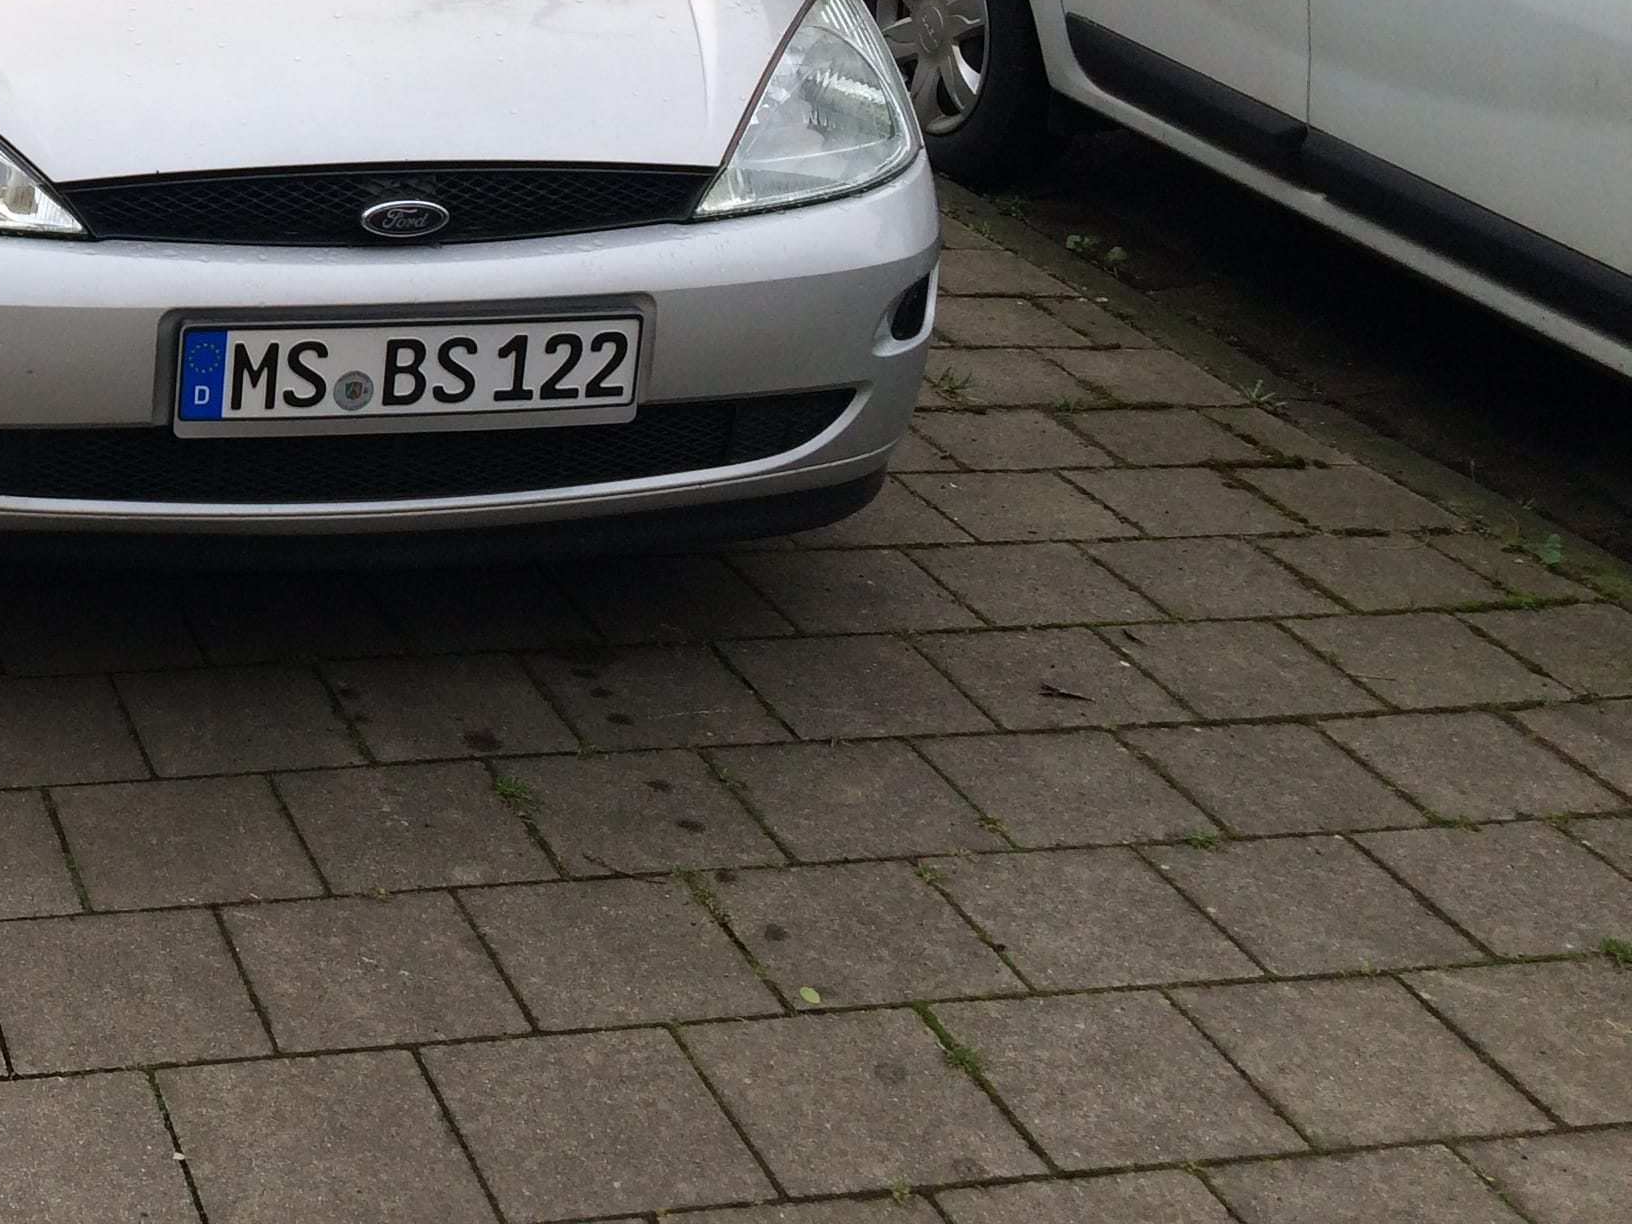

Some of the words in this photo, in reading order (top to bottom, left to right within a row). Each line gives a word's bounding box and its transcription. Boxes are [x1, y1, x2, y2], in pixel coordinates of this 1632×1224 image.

[382, 208, 428, 229] Ford
[230, 340, 329, 410] MS
[193, 385, 210, 405] D
